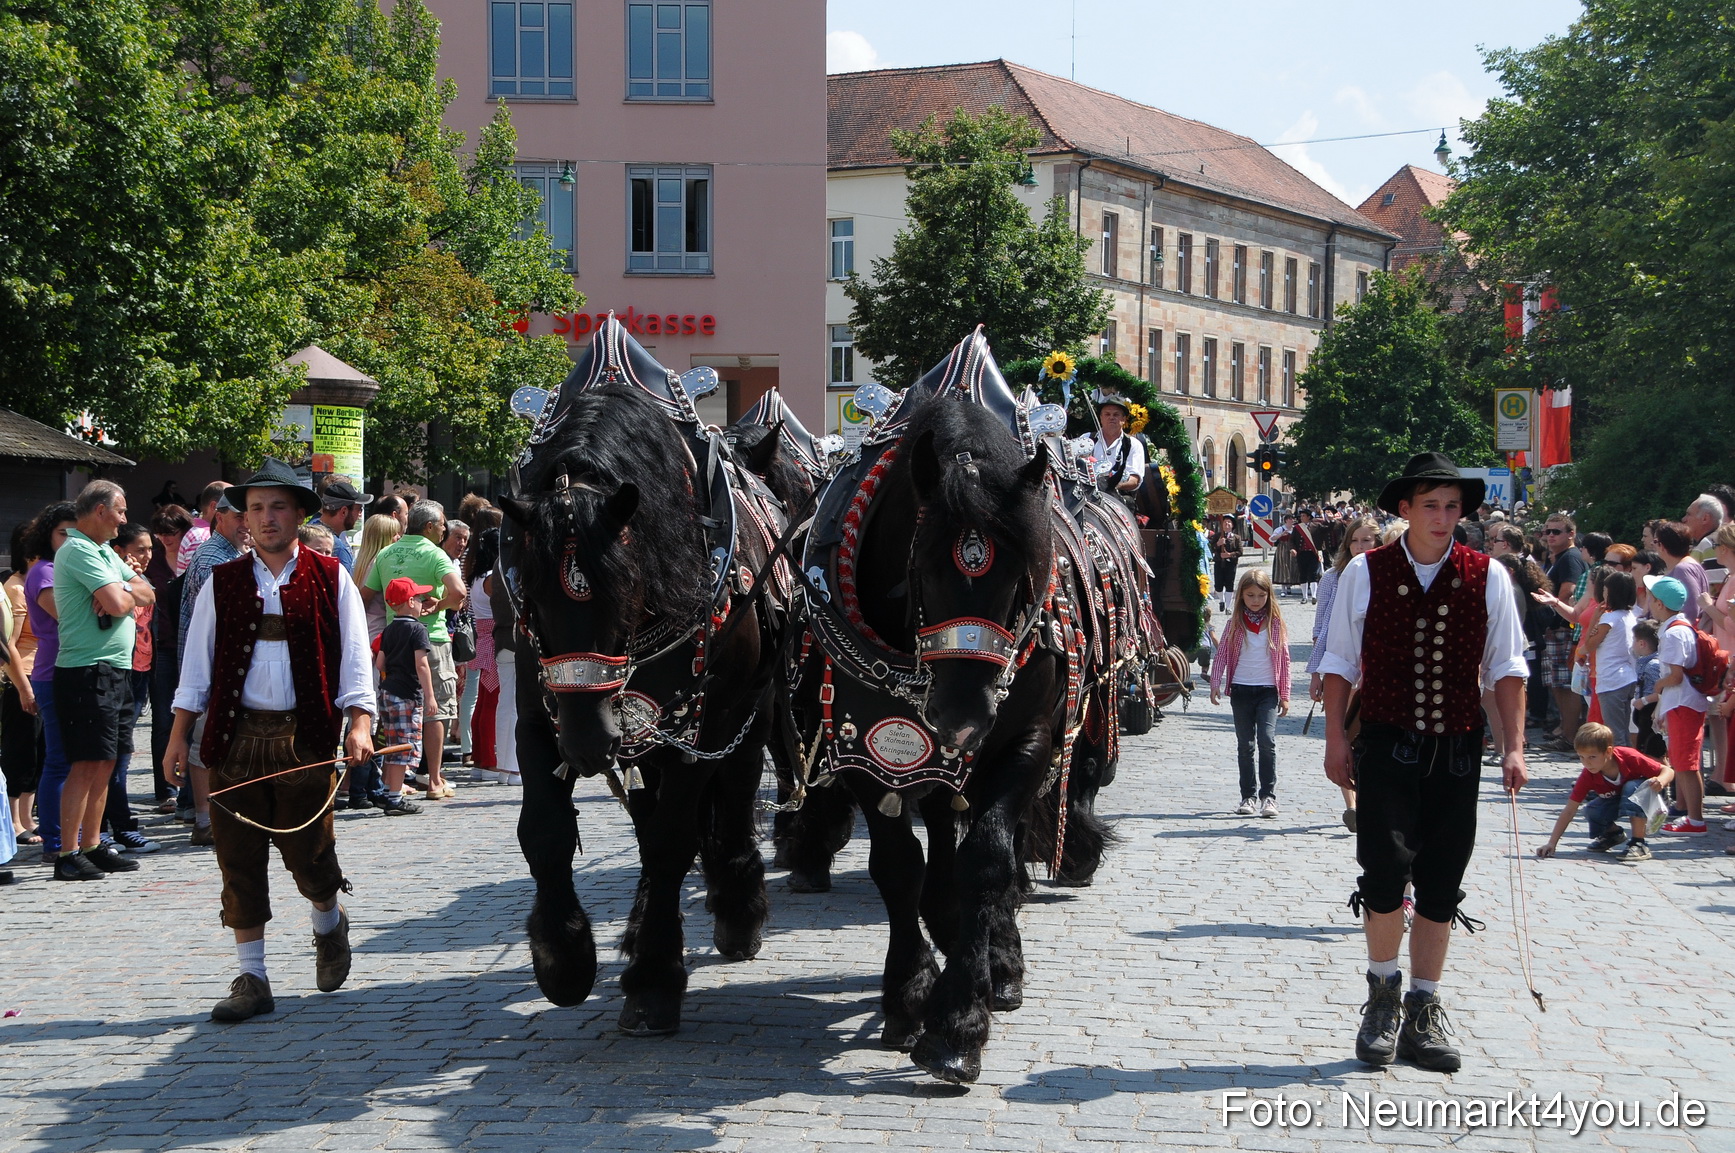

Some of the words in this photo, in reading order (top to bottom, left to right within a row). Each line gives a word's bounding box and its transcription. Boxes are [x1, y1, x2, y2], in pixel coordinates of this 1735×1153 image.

[316, 407, 334, 415] New
[336, 408, 354, 417] Berlin
[888, 730, 911, 738] Stefan
[884, 736, 915, 746] Hofmann
[879, 745, 918, 757] Ehringsfeld
